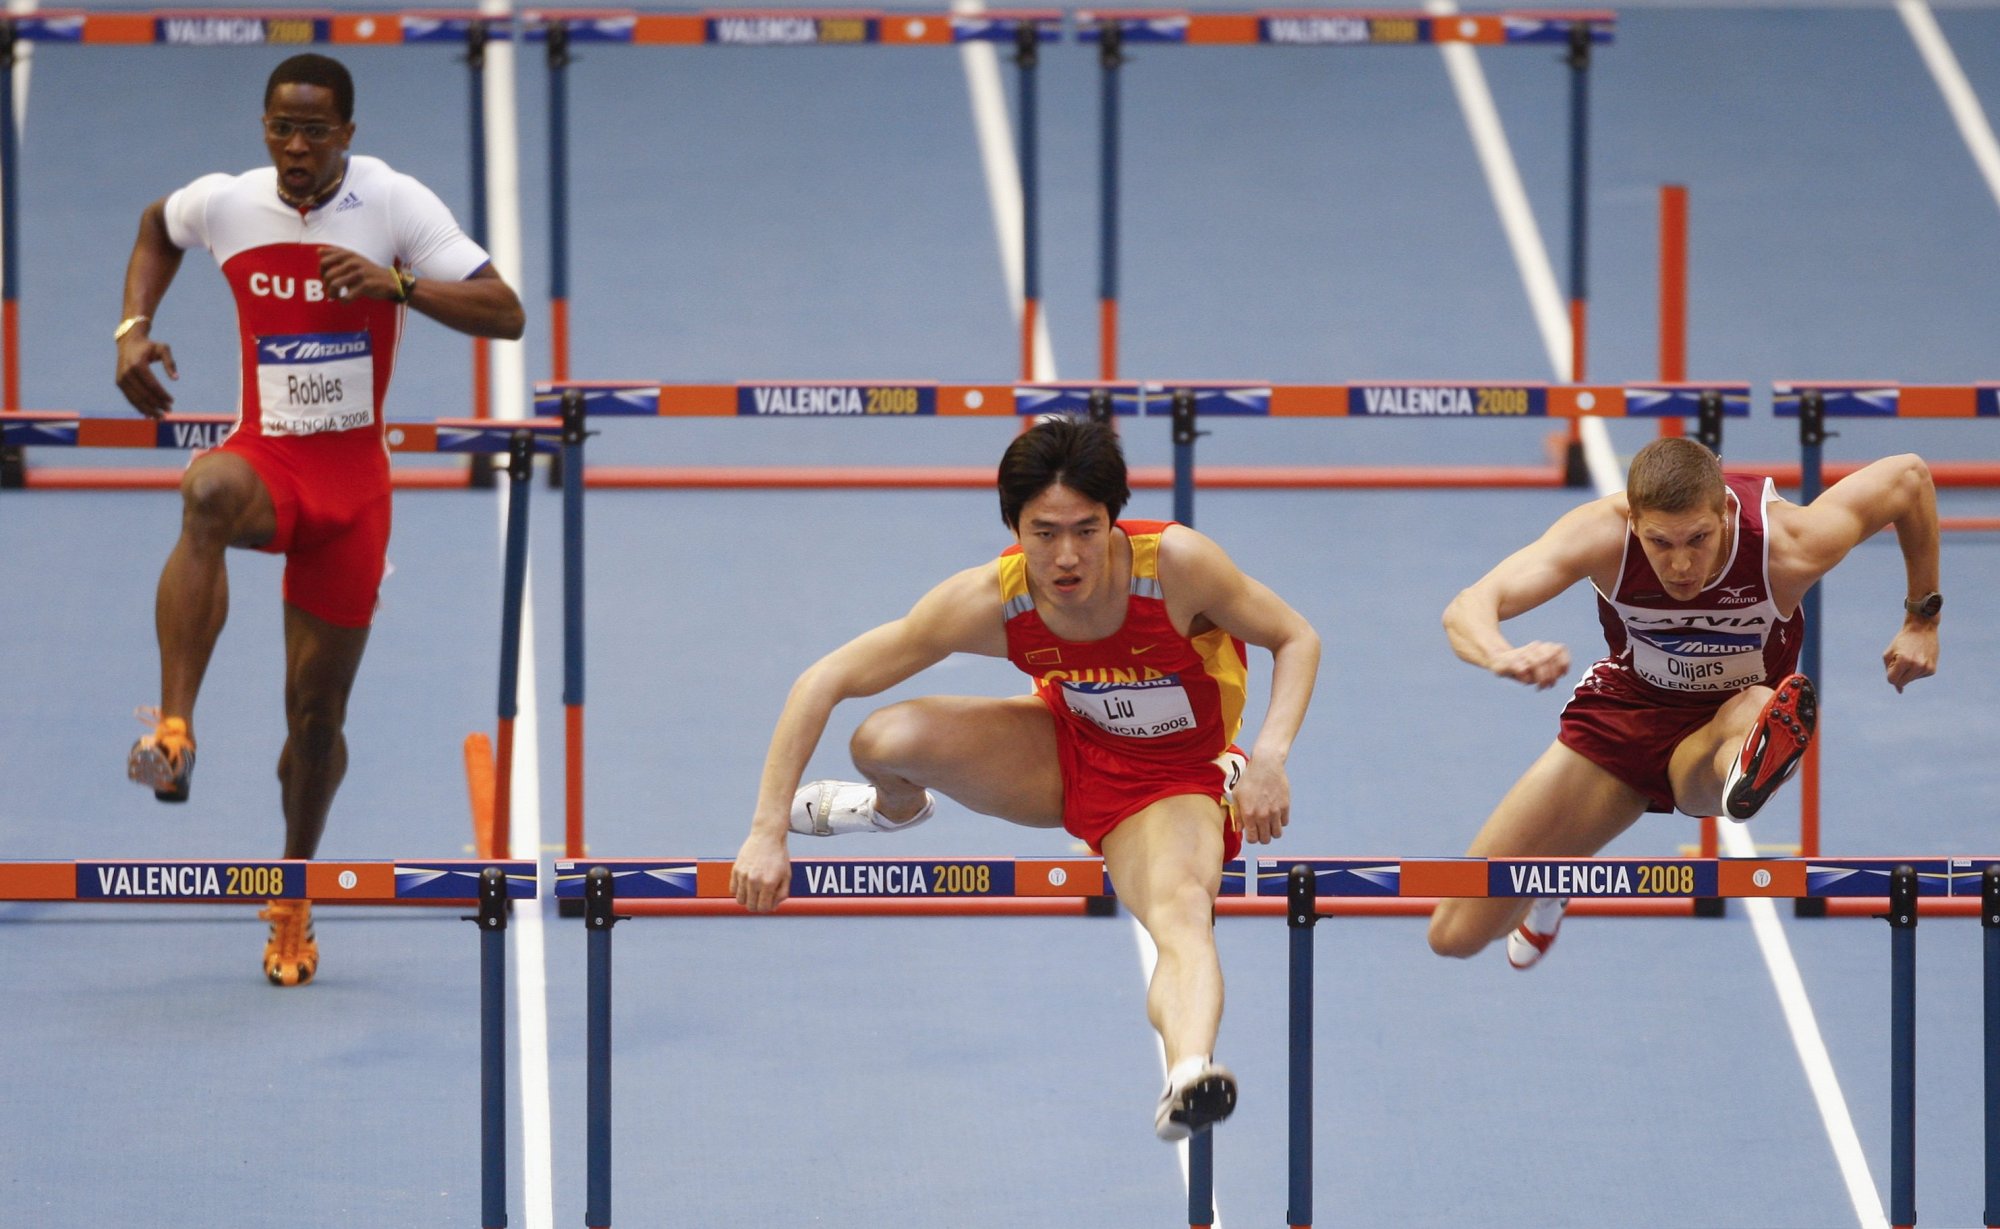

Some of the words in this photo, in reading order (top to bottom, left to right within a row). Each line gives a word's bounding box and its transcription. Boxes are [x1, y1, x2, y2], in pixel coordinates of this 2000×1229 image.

[250, 272, 348, 302] CUB
[288, 374, 343, 405] Robles
[753, 387, 863, 414] VALENCIA
[866, 388, 918, 414] 2008
[1363, 387, 1474, 415] VALENCIA
[1476, 388, 1528, 415] 2008
[341, 411, 370, 428] 2008
[1627, 616, 1766, 627] LATVIA
[1041, 665, 1164, 687] CHINA
[1639, 668, 1719, 690] VALENCIA
[1724, 674, 1760, 689] 2008
[1668, 657, 1724, 682] Olijars
[1103, 697, 1135, 720] Liu
[1152, 717, 1188, 735] 2008
[98, 867, 220, 895] VALENCIA
[226, 866, 284, 895] 2008
[805, 865, 928, 894] VALENCIA
[933, 865, 990, 893] 2008
[1509, 865, 1632, 893] VALENCIA
[1637, 865, 1694, 894] 2008
